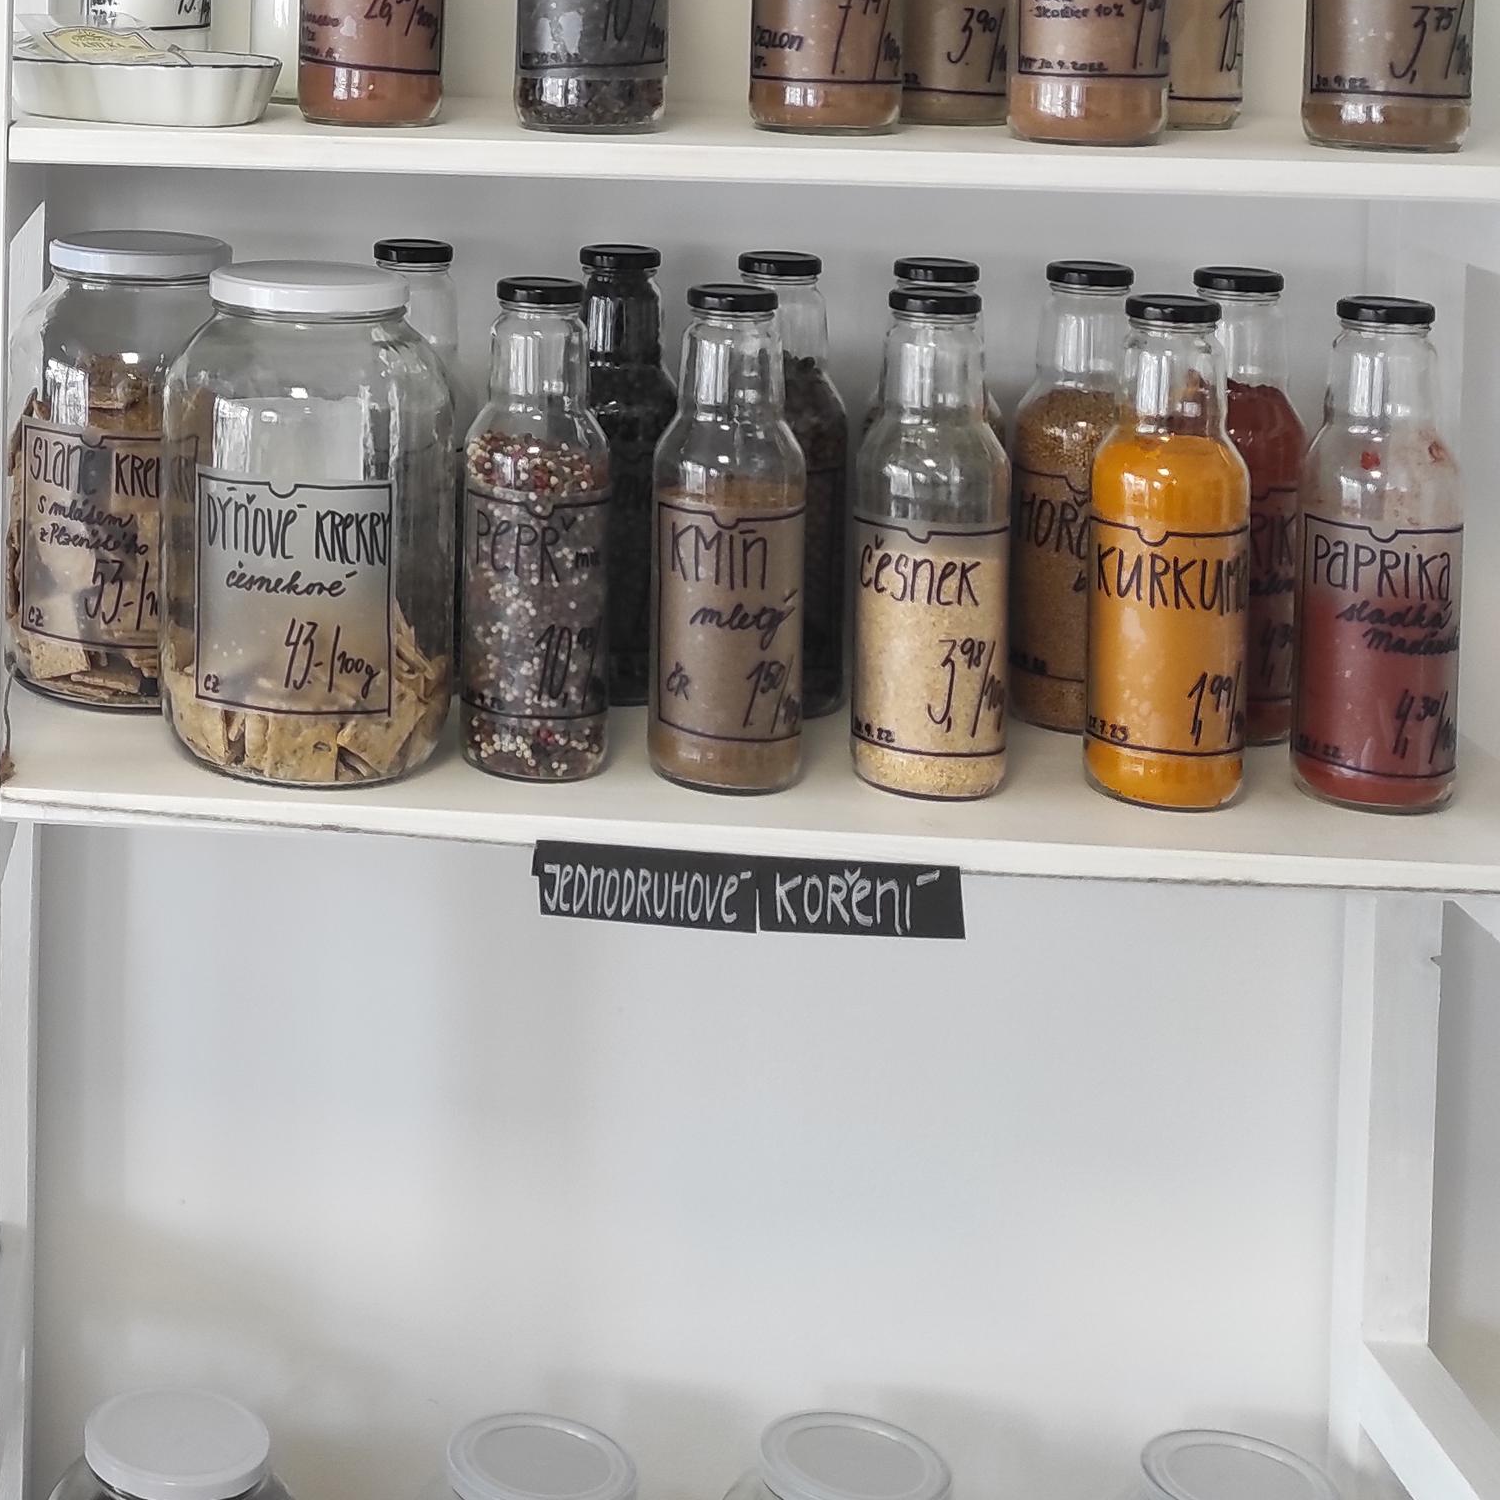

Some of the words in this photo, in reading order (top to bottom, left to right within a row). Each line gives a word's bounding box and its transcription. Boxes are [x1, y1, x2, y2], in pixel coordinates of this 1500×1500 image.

[206, 486, 308, 560] DÝŇOVÉ
[314, 509, 390, 566] KREKRY
[476, 509, 577, 583] PEPŘ
[671, 529, 768, 591] KMÍN
[225, 560, 357, 597] česnekové
[860, 534, 981, 607] ČESNEK
[1097, 543, 1248, 616] KURKUM
[1313, 533, 1451, 601] PAPRIKA
[690, 589, 798, 651] mletý
[666, 661, 692, 701] ČR
[543, 863, 752, 924] JEDNODRUHOVÉ
[775, 866, 941, 935] KOŘENÍ
